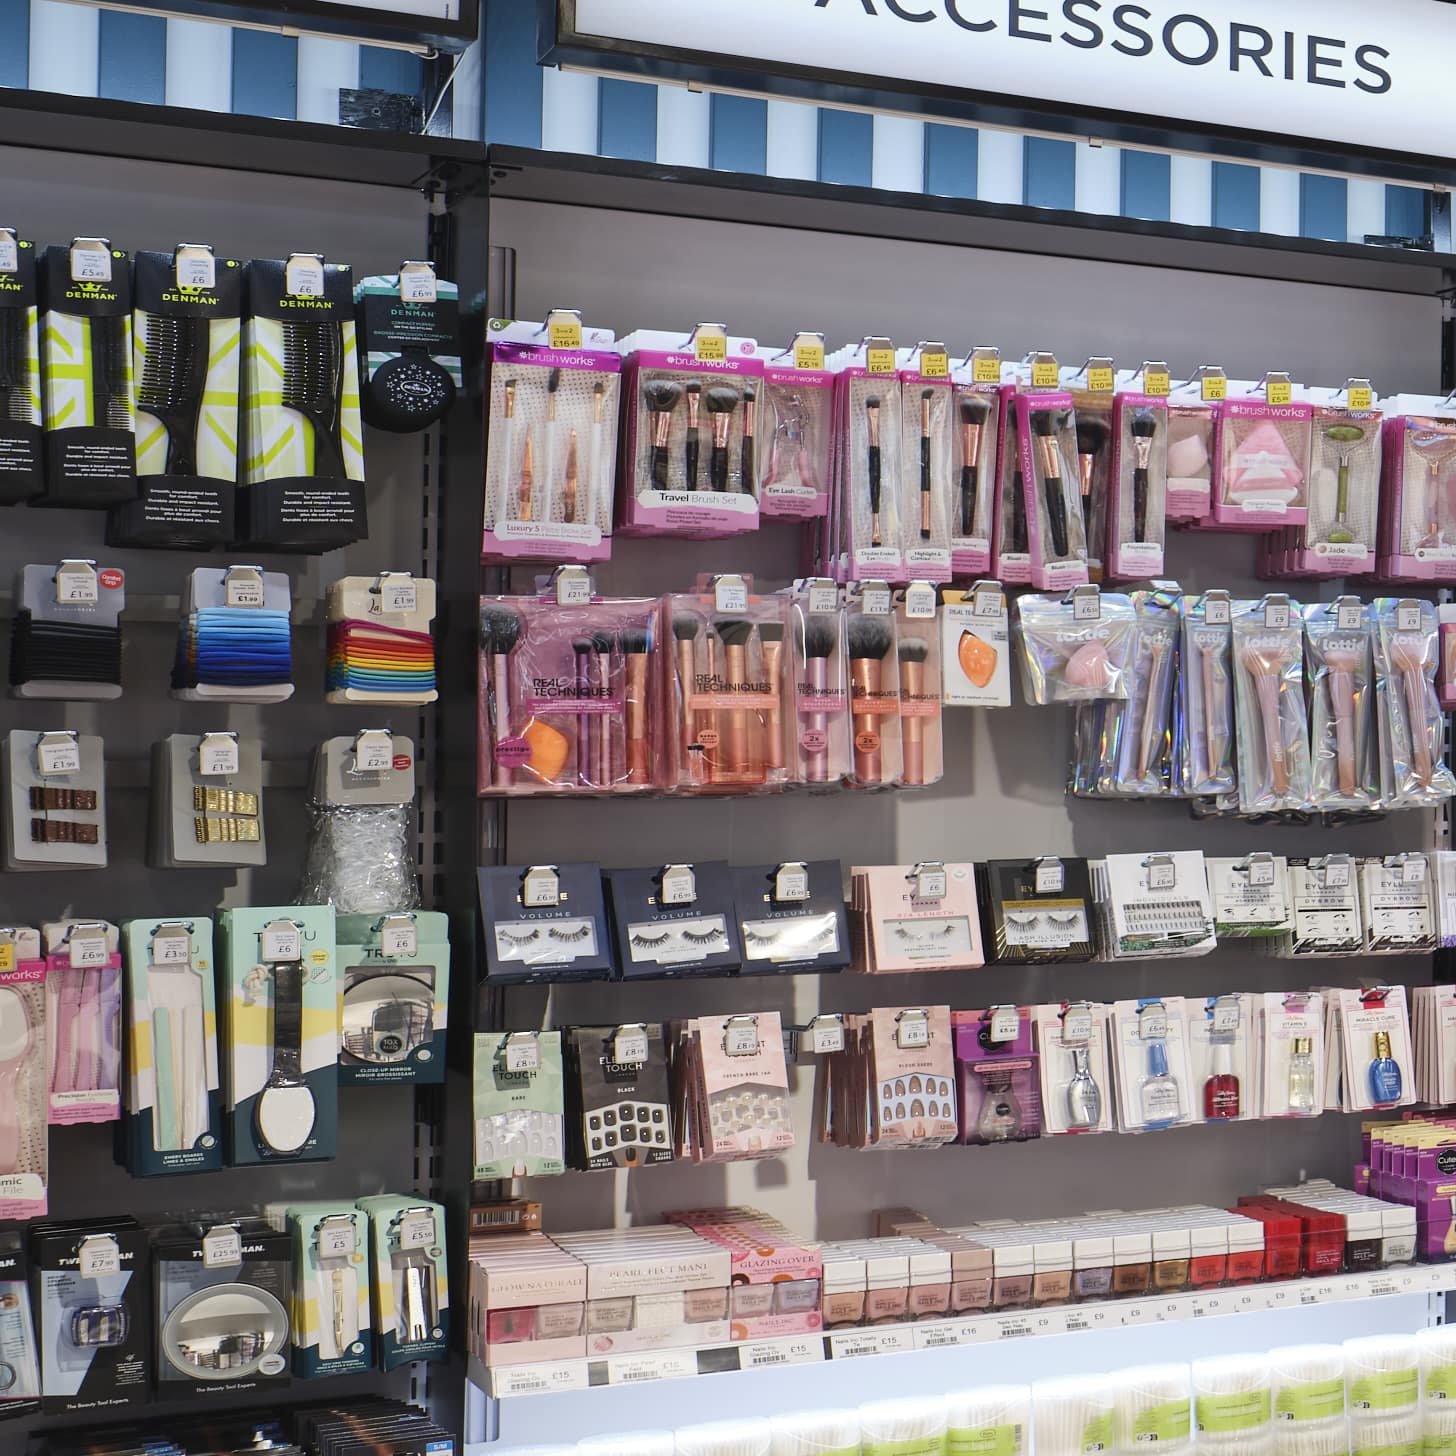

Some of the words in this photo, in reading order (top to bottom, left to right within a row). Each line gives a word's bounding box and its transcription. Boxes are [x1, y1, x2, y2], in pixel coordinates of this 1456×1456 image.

[65, 291, 115, 301] DENMAN
[162, 293, 217, 304] DENMAN
[279, 299, 332, 309] DENMAN
[390, 308, 435, 318] DENMAN
[527, 351, 559, 364] brush
[561, 354, 595, 366] works
[1239, 405, 1270, 417] brush
[1271, 407, 1305, 419] works
[659, 492, 689, 504] Travel
[691, 494, 719, 505] Brush
[722, 495, 737, 505] Set
[533, 678, 562, 688] REAL
[697, 682, 771, 692] TECHNIQUES
[533, 686, 613, 697] TECHNIQUES
[519, 911, 572, 920] VOLUME
[652, 910, 702, 921] VOLUME
[606, 1061, 643, 1073] TOUCH
[498, 1071, 537, 1080] TOUCH
